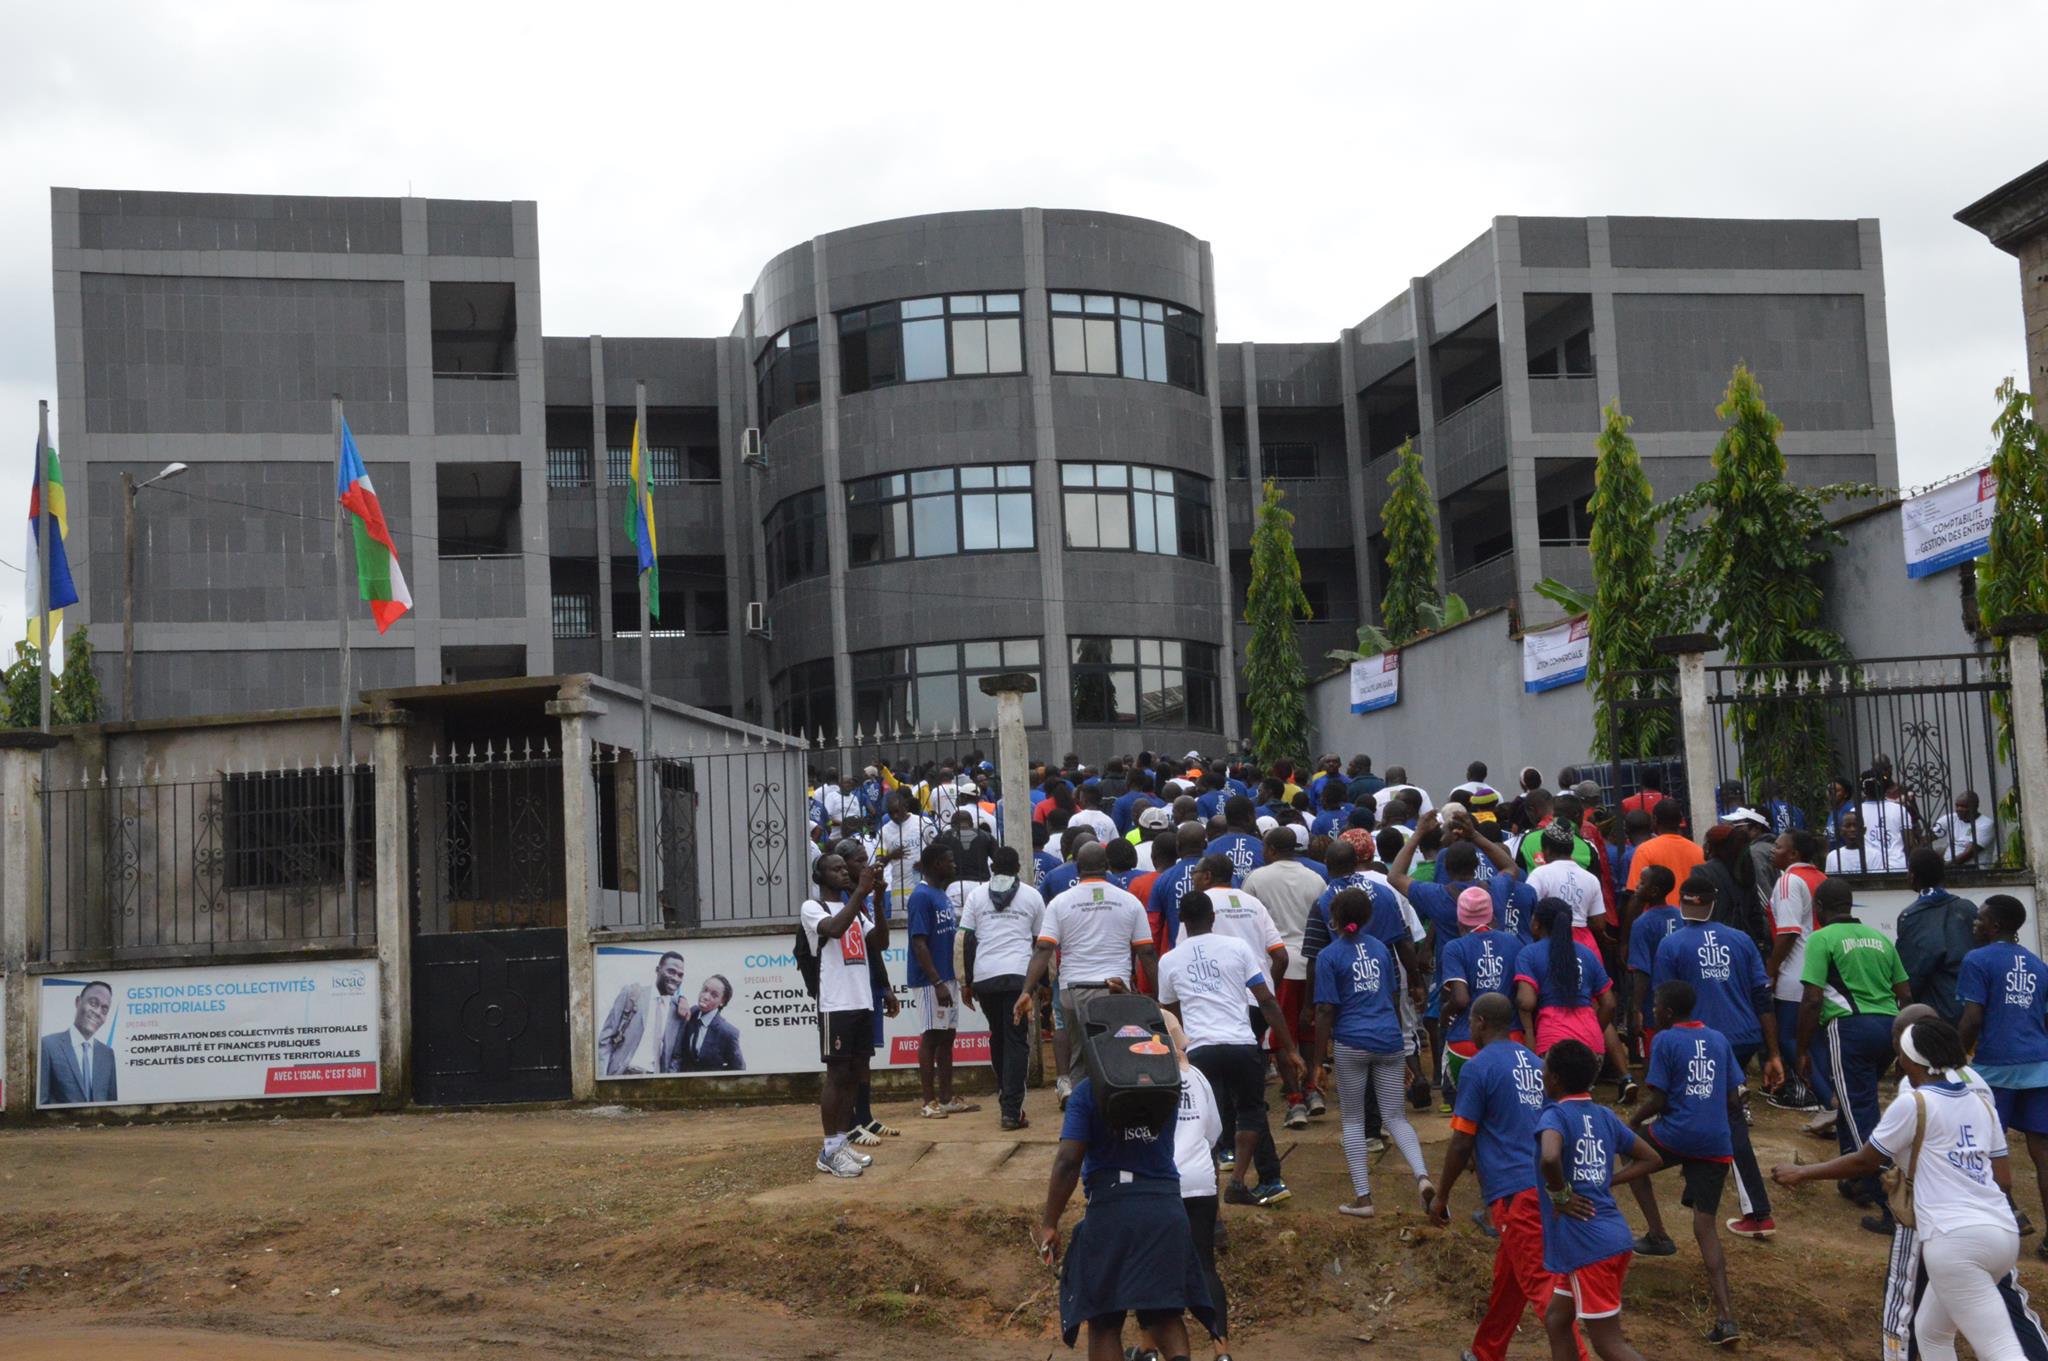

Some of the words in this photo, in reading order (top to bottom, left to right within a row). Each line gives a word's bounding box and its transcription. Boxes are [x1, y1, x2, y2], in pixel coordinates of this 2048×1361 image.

[1932, 507, 1983, 535] COMPTABILITE
[1920, 535, 1948, 553] GESTION
[1948, 528, 1962, 543] DES
[1233, 838, 1247, 851] JE
[1703, 930, 1718, 947] JE
[1192, 945, 1206, 961] JE
[1355, 943, 1369, 960] JE
[1483, 940, 1494, 957] JE
[2012, 955, 2027, 972] JE
[127, 986, 185, 1000] GESTION
[187, 984, 213, 997] DES
[215, 976, 316, 996] COLLECTIVITÉS
[753, 989, 804, 1000] ACTION
[126, 1000, 226, 1015] TERRITORIALES
[755, 1017, 780, 1027] DES
[130, 1032, 209, 1041] ADMINISTRATION
[210, 1030, 227, 1038] DES
[228, 1026, 295, 1037] COLLECTIVITÉS
[296, 1024, 368, 1034] TERRITORIALES
[130, 1042, 202, 1054] COMPTABILITÉ
[204, 1043, 216, 1051] ET
[217, 1041, 266, 1049] FINANCES
[267, 1039, 321, 1048] PUBLIQUES
[899, 1040, 919, 1051] AVEC
[954, 1038, 975, 1049] C'EST
[1694, 1039, 1707, 1059] JE
[129, 1055, 185, 1067] FISCALITÉS
[186, 1056, 206, 1064] DES
[283, 1050, 361, 1060] TERRITORIALES
[1515, 1050, 1531, 1068] JE
[273, 1071, 293, 1081] AVEC
[325, 1068, 345, 1079] C'EST
[346, 1065, 362, 1077] SÛR
[1583, 1114, 1595, 1138] JE
[1956, 1125, 1976, 1148] JE
